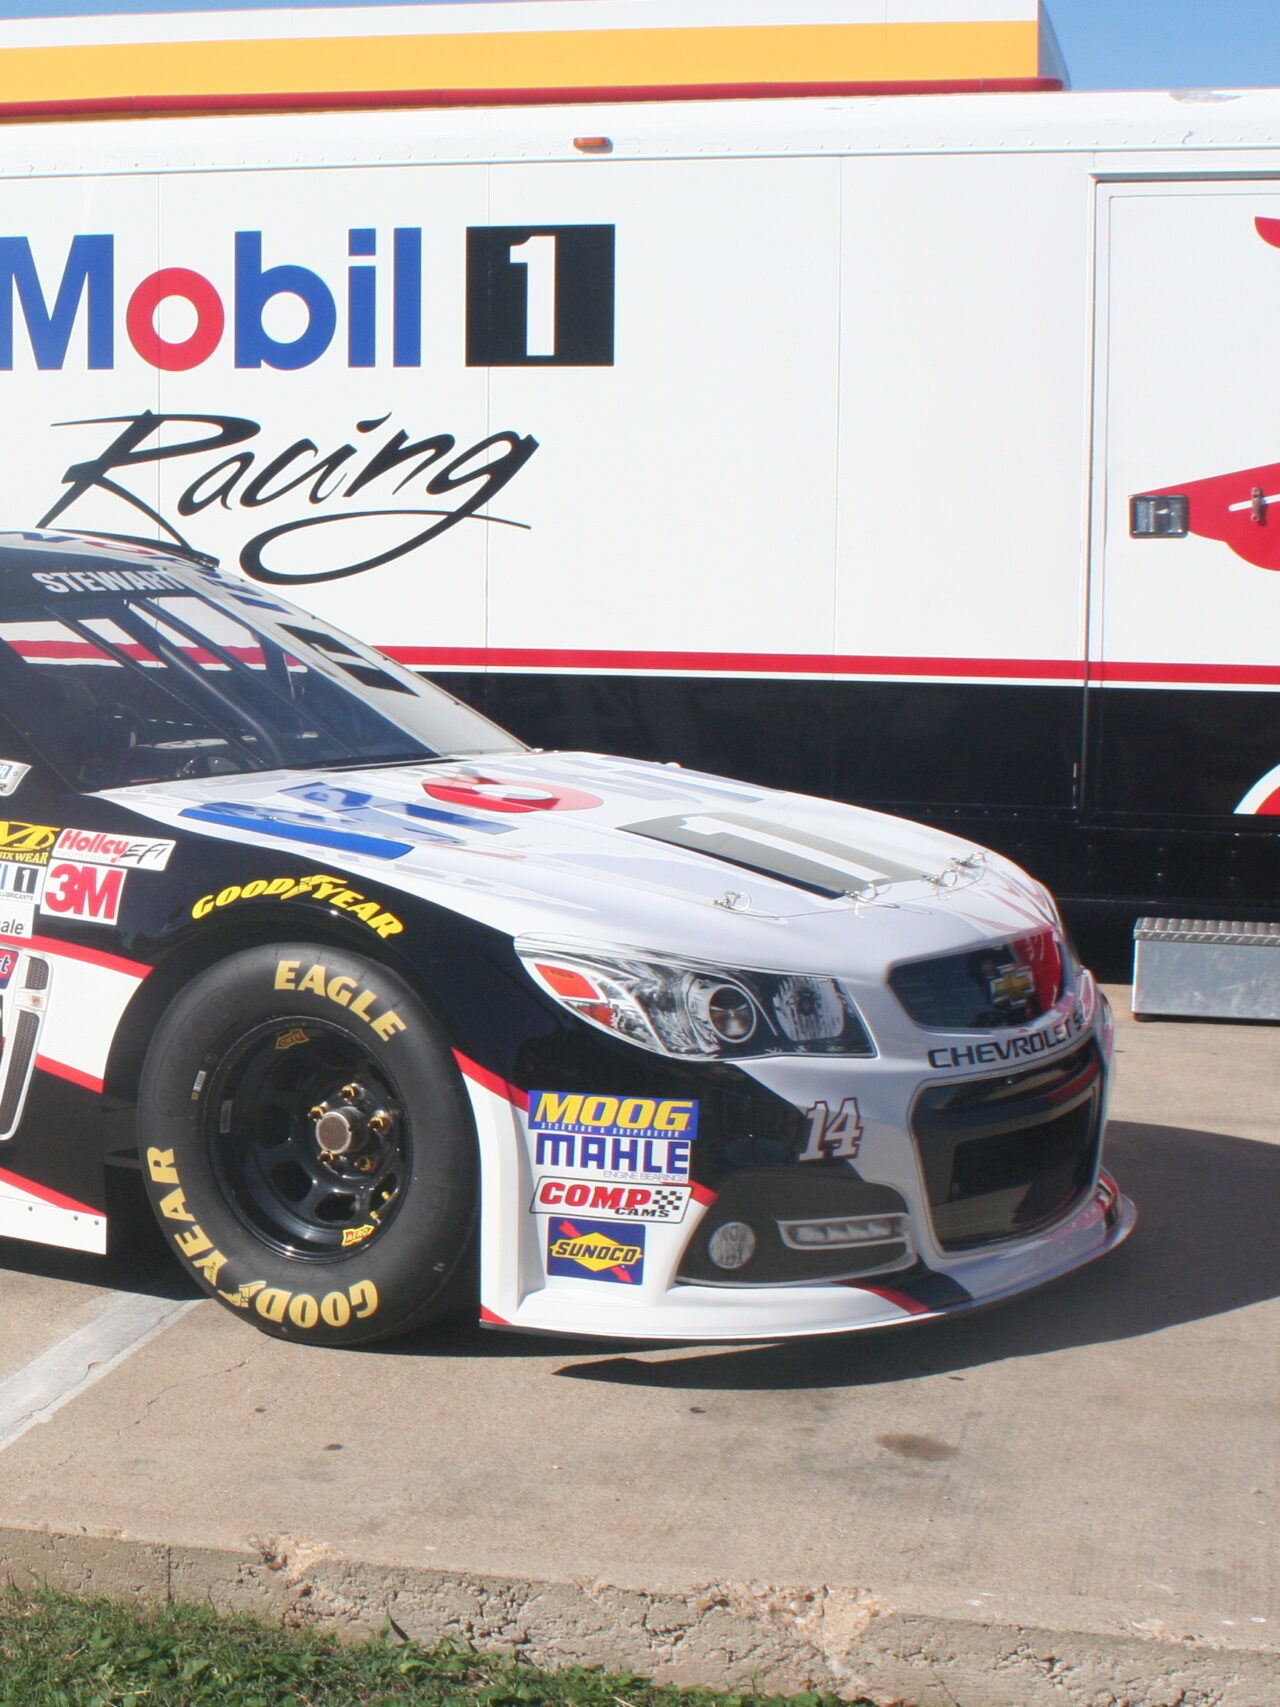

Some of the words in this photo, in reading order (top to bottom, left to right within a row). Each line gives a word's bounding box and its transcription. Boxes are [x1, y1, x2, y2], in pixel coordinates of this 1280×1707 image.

[35, 410, 540, 585] Racing
[32, 570, 186, 594] STEWART
[14, 851, 48, 865] WEAR
[58, 829, 129, 862] Holley
[45, 863, 124, 919] 3M
[192, 874, 405, 940] GOODYEAR
[274, 960, 408, 1042] EAGLE
[928, 1019, 1072, 1069] CHEVROLET
[534, 1092, 693, 1132] MOOG
[541, 1122, 592, 1133] STEERING
[798, 1097, 863, 1162] 14
[536, 1132, 689, 1174] MAHLE
[603, 1171, 640, 1181] ENGINE
[640, 1173, 688, 1183] BEARINGS
[539, 1182, 652, 1210] COMP
[614, 1206, 671, 1218] CAMS
[555, 1242, 638, 1263] SUNOCO
